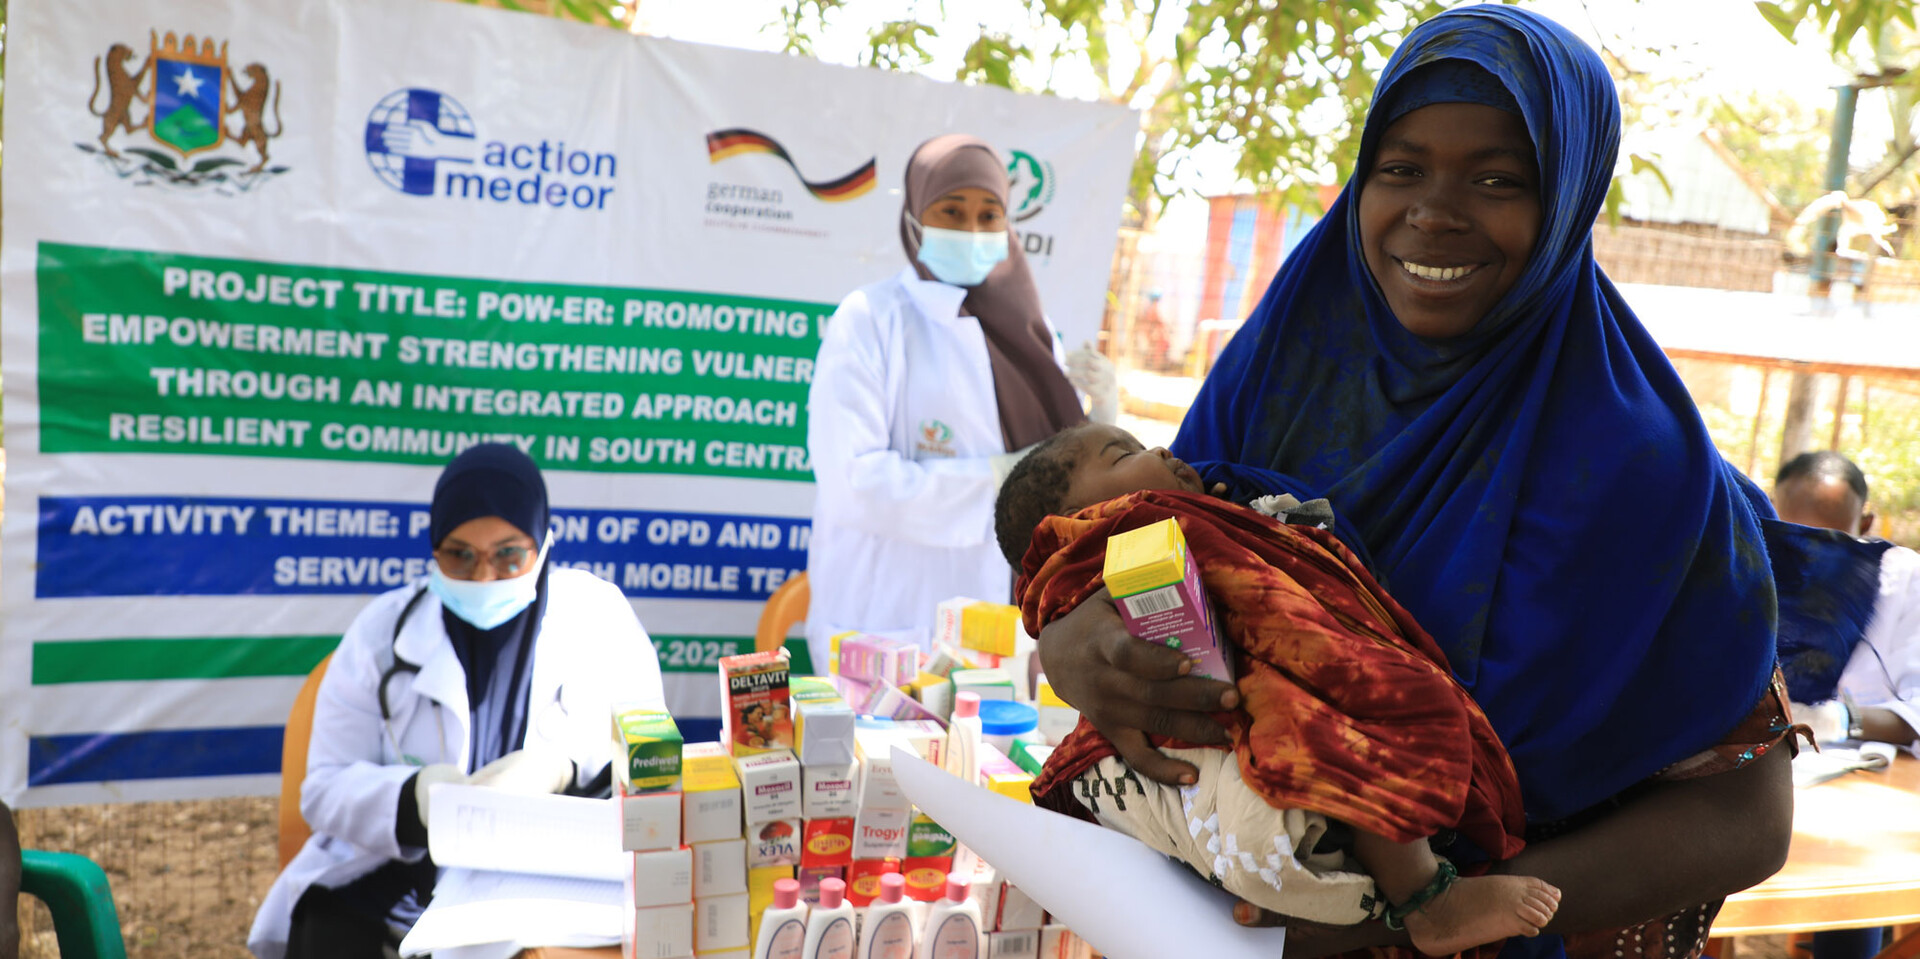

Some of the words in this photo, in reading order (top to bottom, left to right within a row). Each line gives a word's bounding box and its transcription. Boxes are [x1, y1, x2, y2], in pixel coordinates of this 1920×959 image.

[484, 141, 616, 177] action
[447, 173, 613, 209] medeor
[707, 182, 783, 203] german
[164, 267, 343, 308] PROJECT
[353, 283, 466, 318] TITLE:
[477, 291, 614, 326] POW-ER:
[623, 300, 808, 338] PROMOTING
[82, 313, 388, 359] EMPOWERMENT
[398, 337, 682, 375] STRENGTHENING
[692, 350, 814, 383] VULNER
[150, 367, 341, 402] THROUGH
[350, 380, 401, 407] AN
[413, 384, 624, 418] INTEGRATED
[632, 394, 797, 427] APPROACH
[109, 413, 311, 446] RESILIENT
[545, 436, 579, 461] IN
[589, 437, 695, 465] SOUTH
[71, 505, 254, 535] ACTIVITY
[265, 507, 399, 537] THEME:
[597, 517, 640, 543] OF
[647, 519, 710, 545] OPD
[717, 523, 782, 549] AND
[623, 563, 742, 591] MOBILE
[653, 640, 738, 667] -2025
[731, 671, 787, 689] DELTAVIT
[633, 755, 679, 768] Prediwell
[862, 826, 904, 840] Trogyl
[760, 843, 794, 856] VLEX
